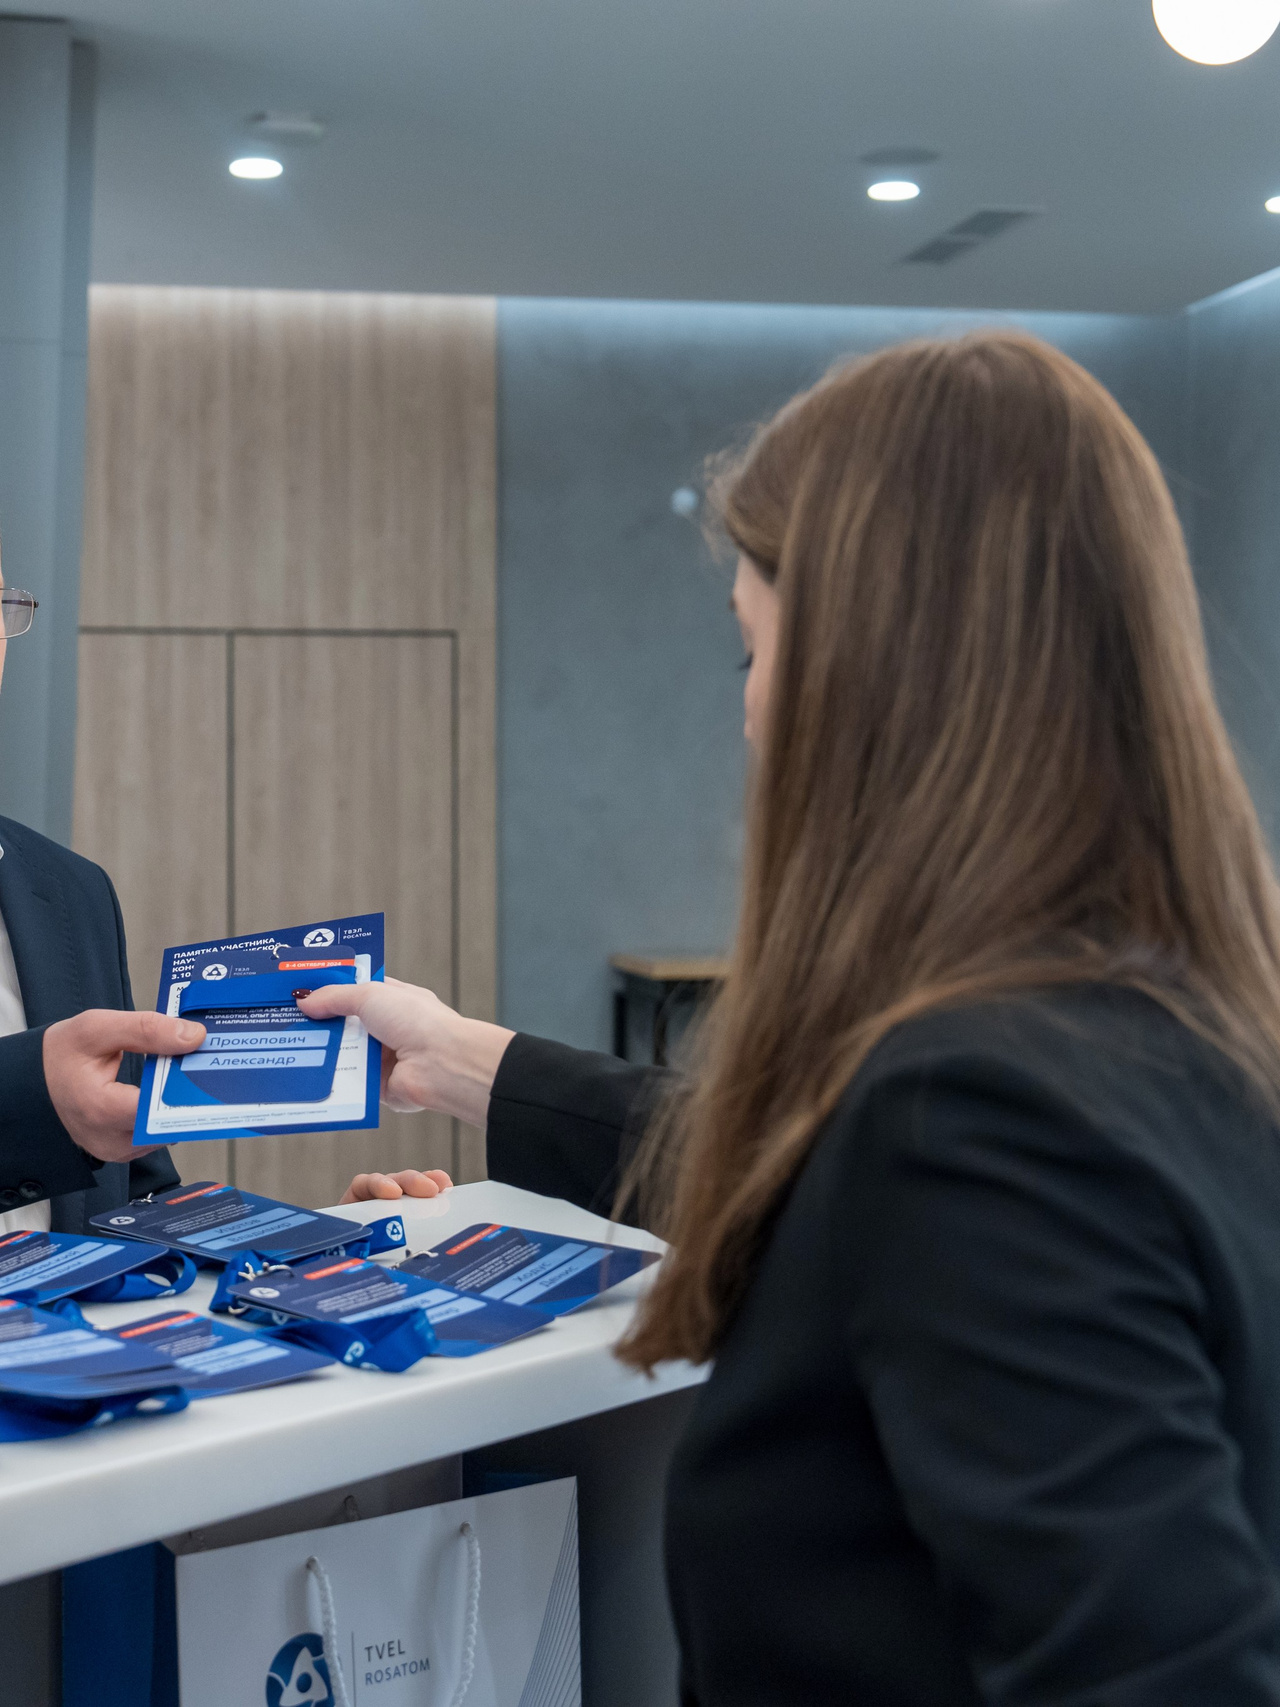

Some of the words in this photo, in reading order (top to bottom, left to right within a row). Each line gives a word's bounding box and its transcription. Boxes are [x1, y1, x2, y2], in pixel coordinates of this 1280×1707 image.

[343, 931, 372, 940] РОСАТОМ
[173, 946, 219, 959] ПАМЯТКА
[220, 937, 276, 952] УЧАСТНИКА
[209, 1035, 307, 1048] Прокопович
[209, 1055, 297, 1067] Александр
[364, 1638, 406, 1663] TVEL
[365, 1657, 431, 1686] ROSATOM
